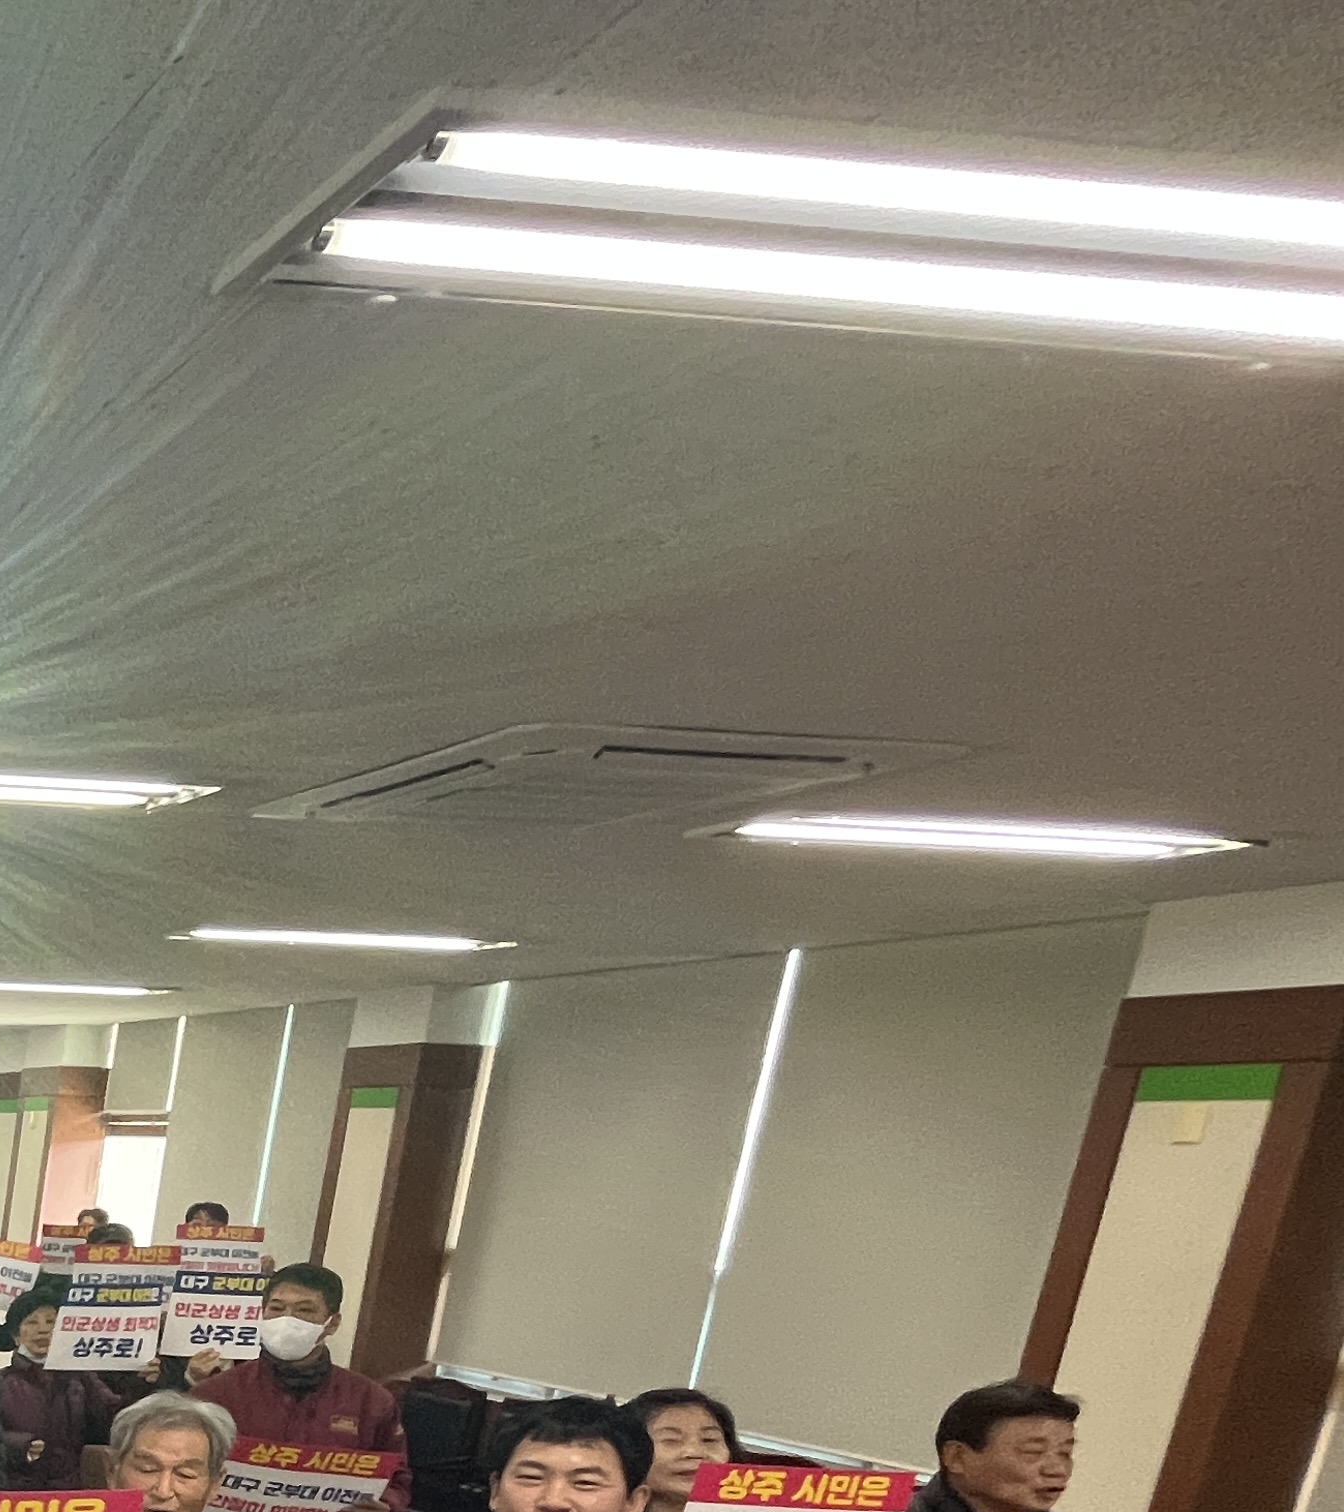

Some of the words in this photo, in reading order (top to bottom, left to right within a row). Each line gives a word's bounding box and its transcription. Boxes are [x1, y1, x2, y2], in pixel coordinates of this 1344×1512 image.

[180, 1275, 209, 1289] 대구
[212, 1276, 254, 1291] 군부대
[67, 1288, 95, 1302] 대구
[175, 1302, 242, 1320] 민군상생
[190, 1324, 259, 1346] 상주로
[73, 1337, 143, 1358] 상주로!
[249, 1443, 302, 1468] 상주
[303, 1451, 381, 1476] 시민은
[221, 1474, 262, 1491] 대구
[264, 1481, 321, 1501] 군부대
[718, 1468, 787, 1502] 상주
[791, 1473, 891, 1507] 시민은
